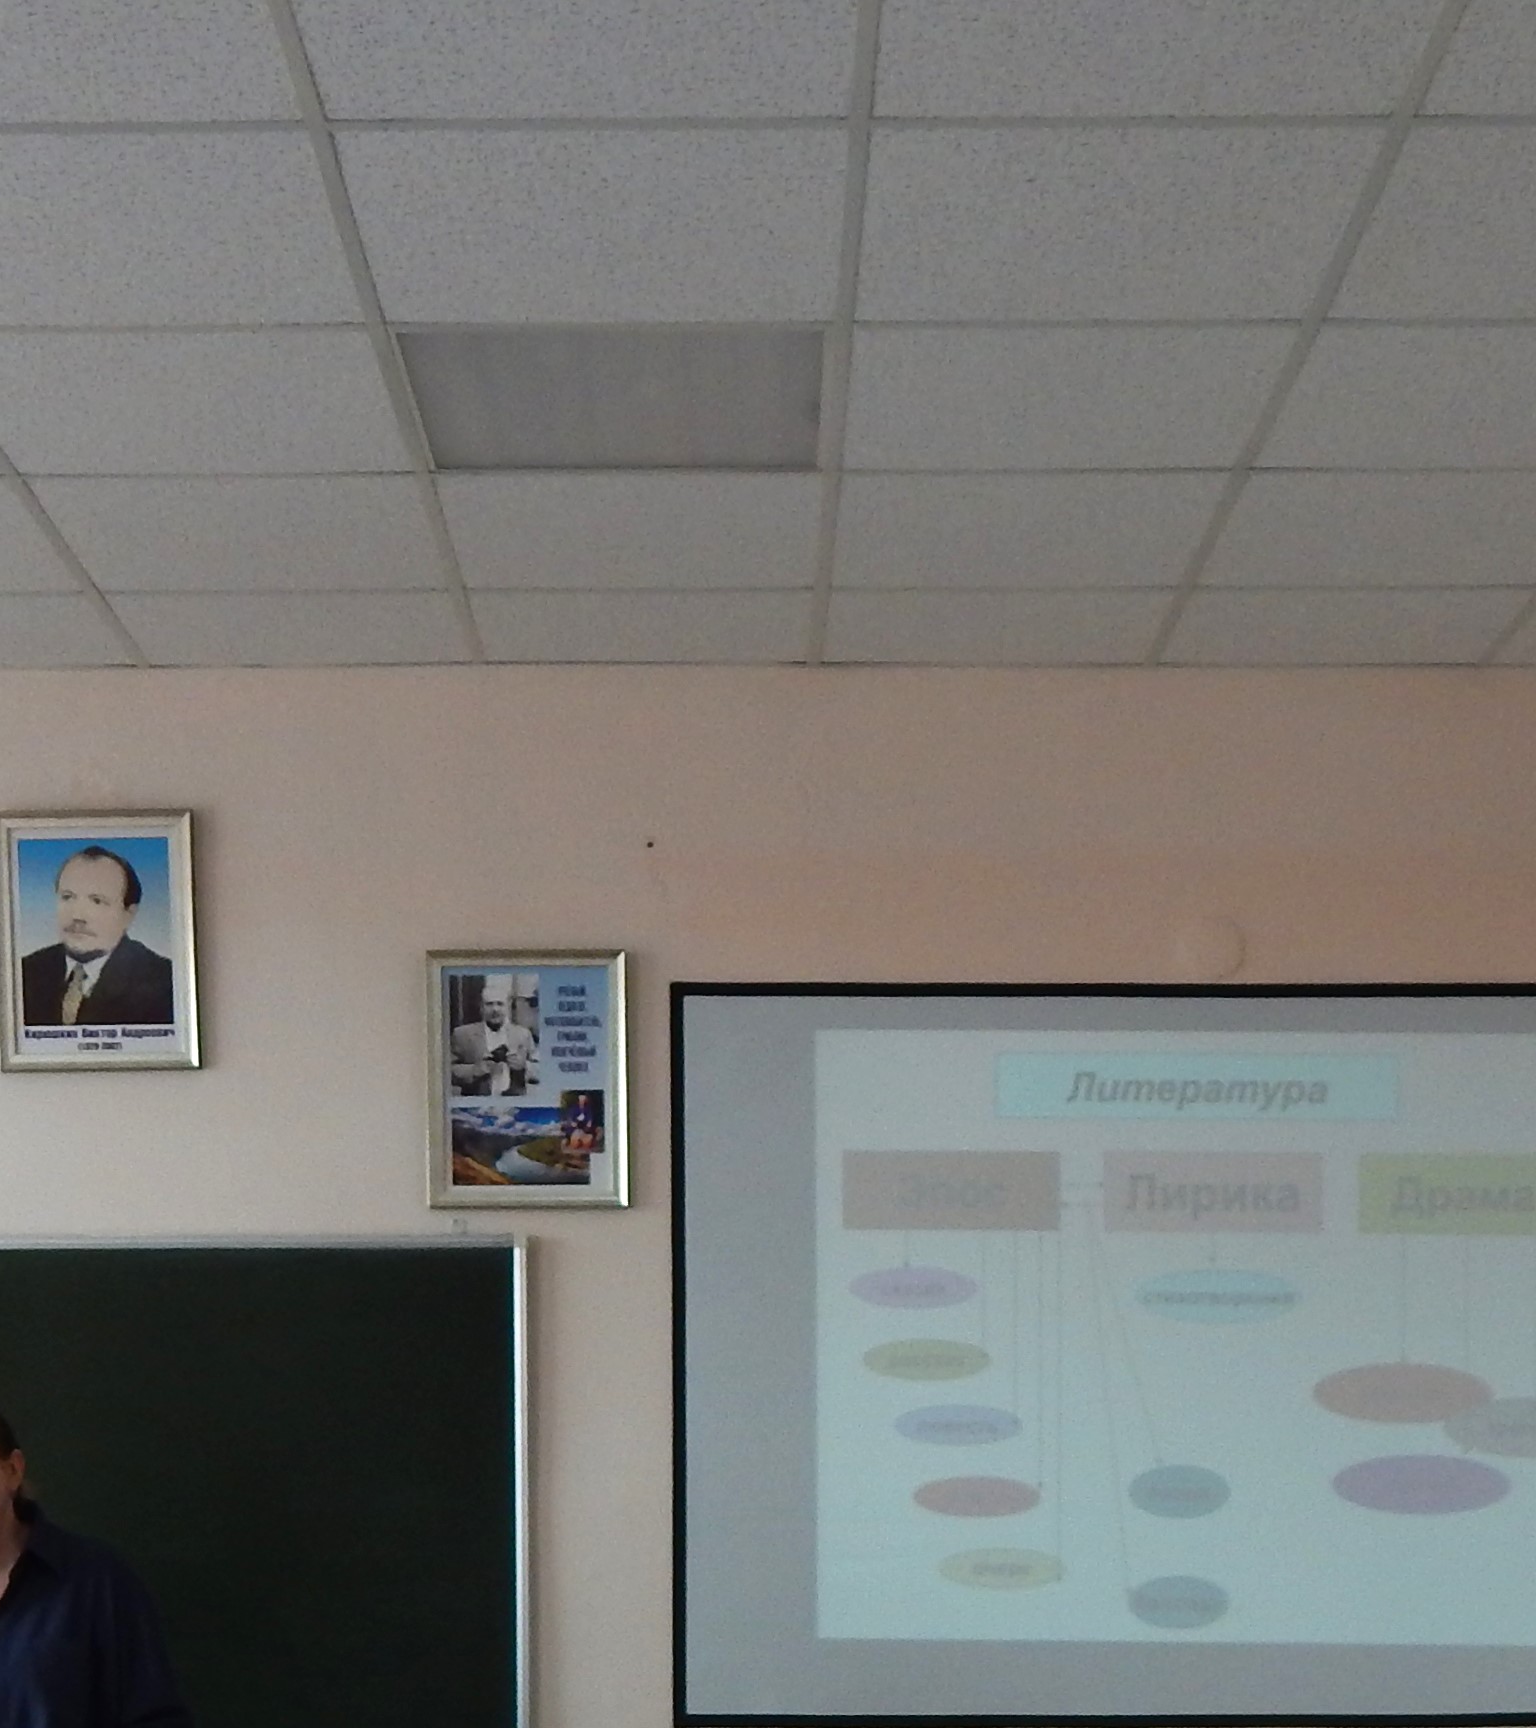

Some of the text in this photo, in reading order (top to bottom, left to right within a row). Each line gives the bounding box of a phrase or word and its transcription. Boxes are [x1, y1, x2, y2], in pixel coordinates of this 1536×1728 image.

[1066, 1070, 1331, 1111] Литература
[1125, 1172, 1301, 1221] Лирика
[1390, 1175, 1536, 1219] Драма
